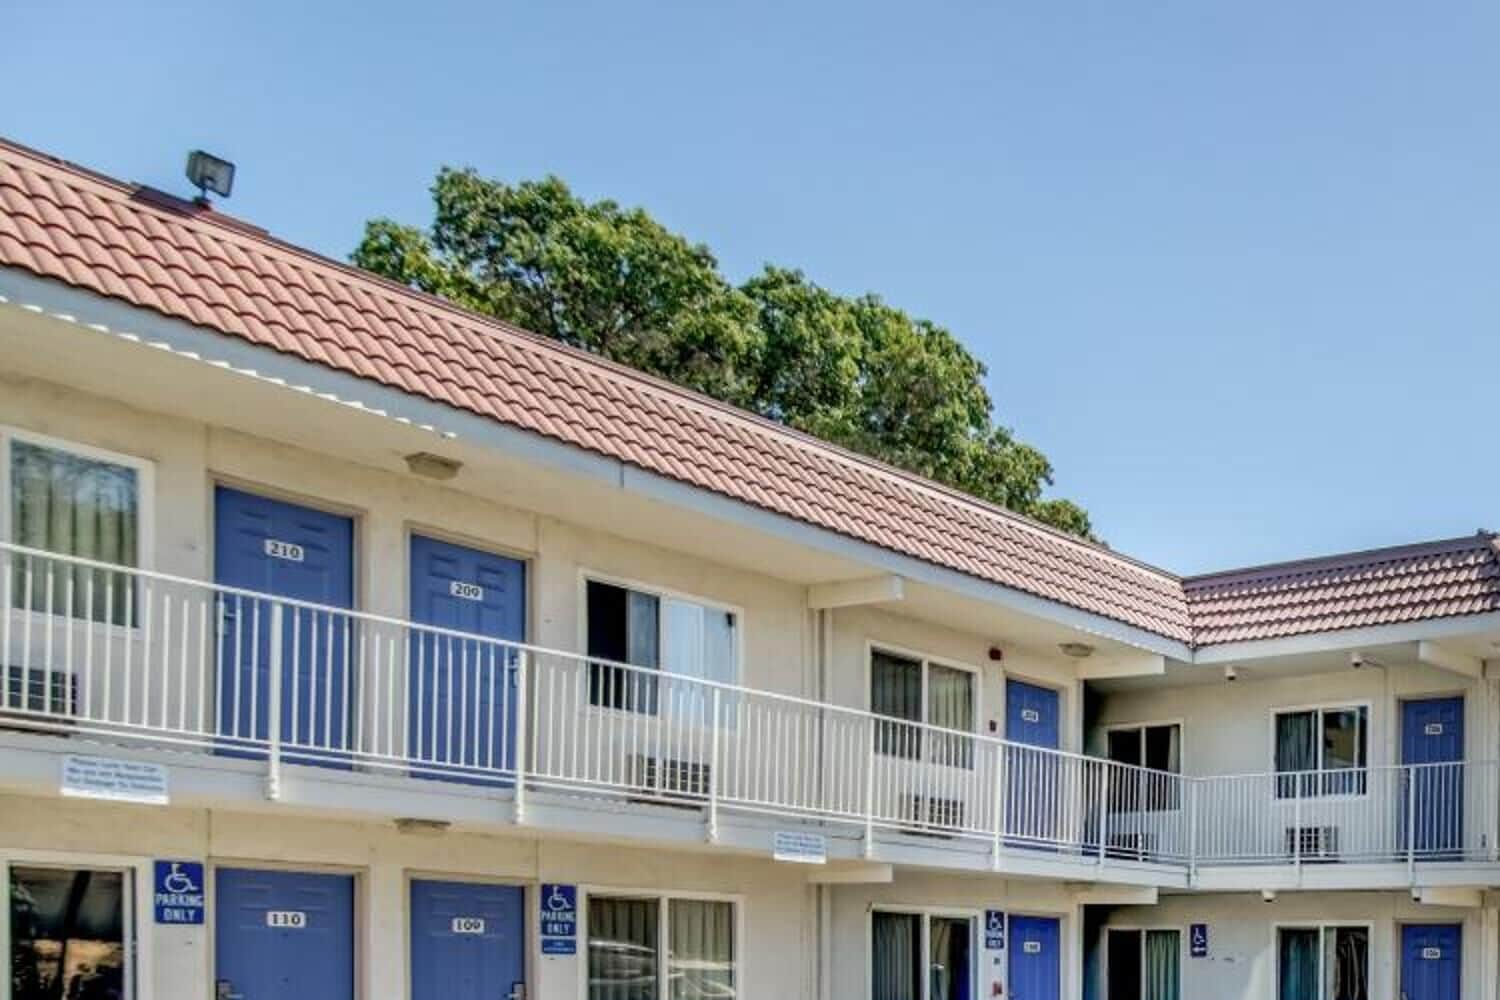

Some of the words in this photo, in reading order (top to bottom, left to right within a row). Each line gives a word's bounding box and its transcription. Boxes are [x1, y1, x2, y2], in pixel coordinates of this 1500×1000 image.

[271, 543, 301, 559] 210
[455, 583, 481, 597] 209
[156, 893, 203, 907] PARKING
[163, 908, 196, 921] ONLY
[271, 913, 302, 925] 110
[457, 919, 481, 931] 109
